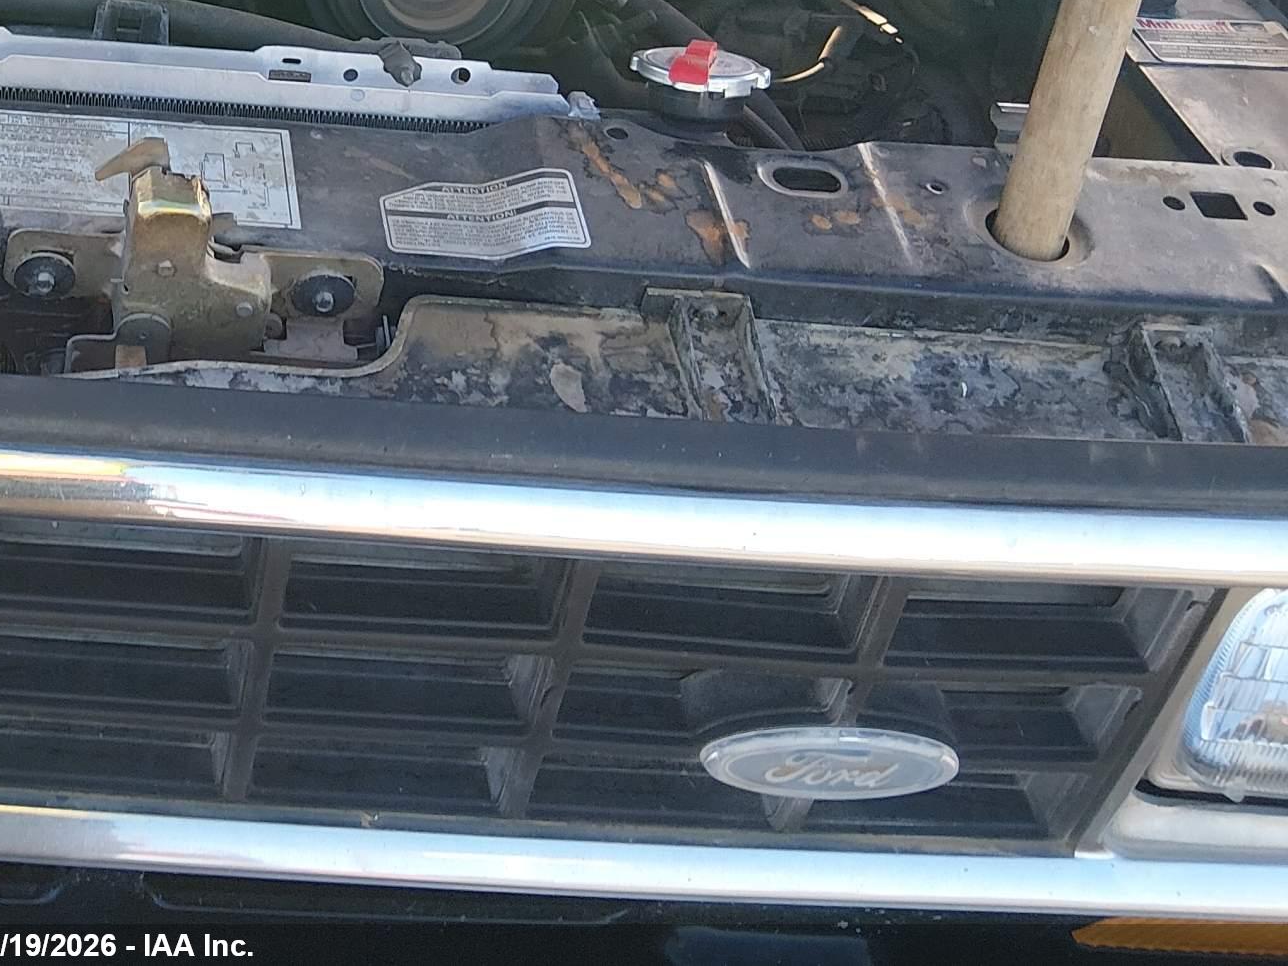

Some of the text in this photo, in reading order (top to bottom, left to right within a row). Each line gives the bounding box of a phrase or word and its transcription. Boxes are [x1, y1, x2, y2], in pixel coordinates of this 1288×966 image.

[1136, 17, 1232, 33] Motorcraft
[441, 180, 508, 193] ATTENTION
[764, 749, 899, 787] Ford
